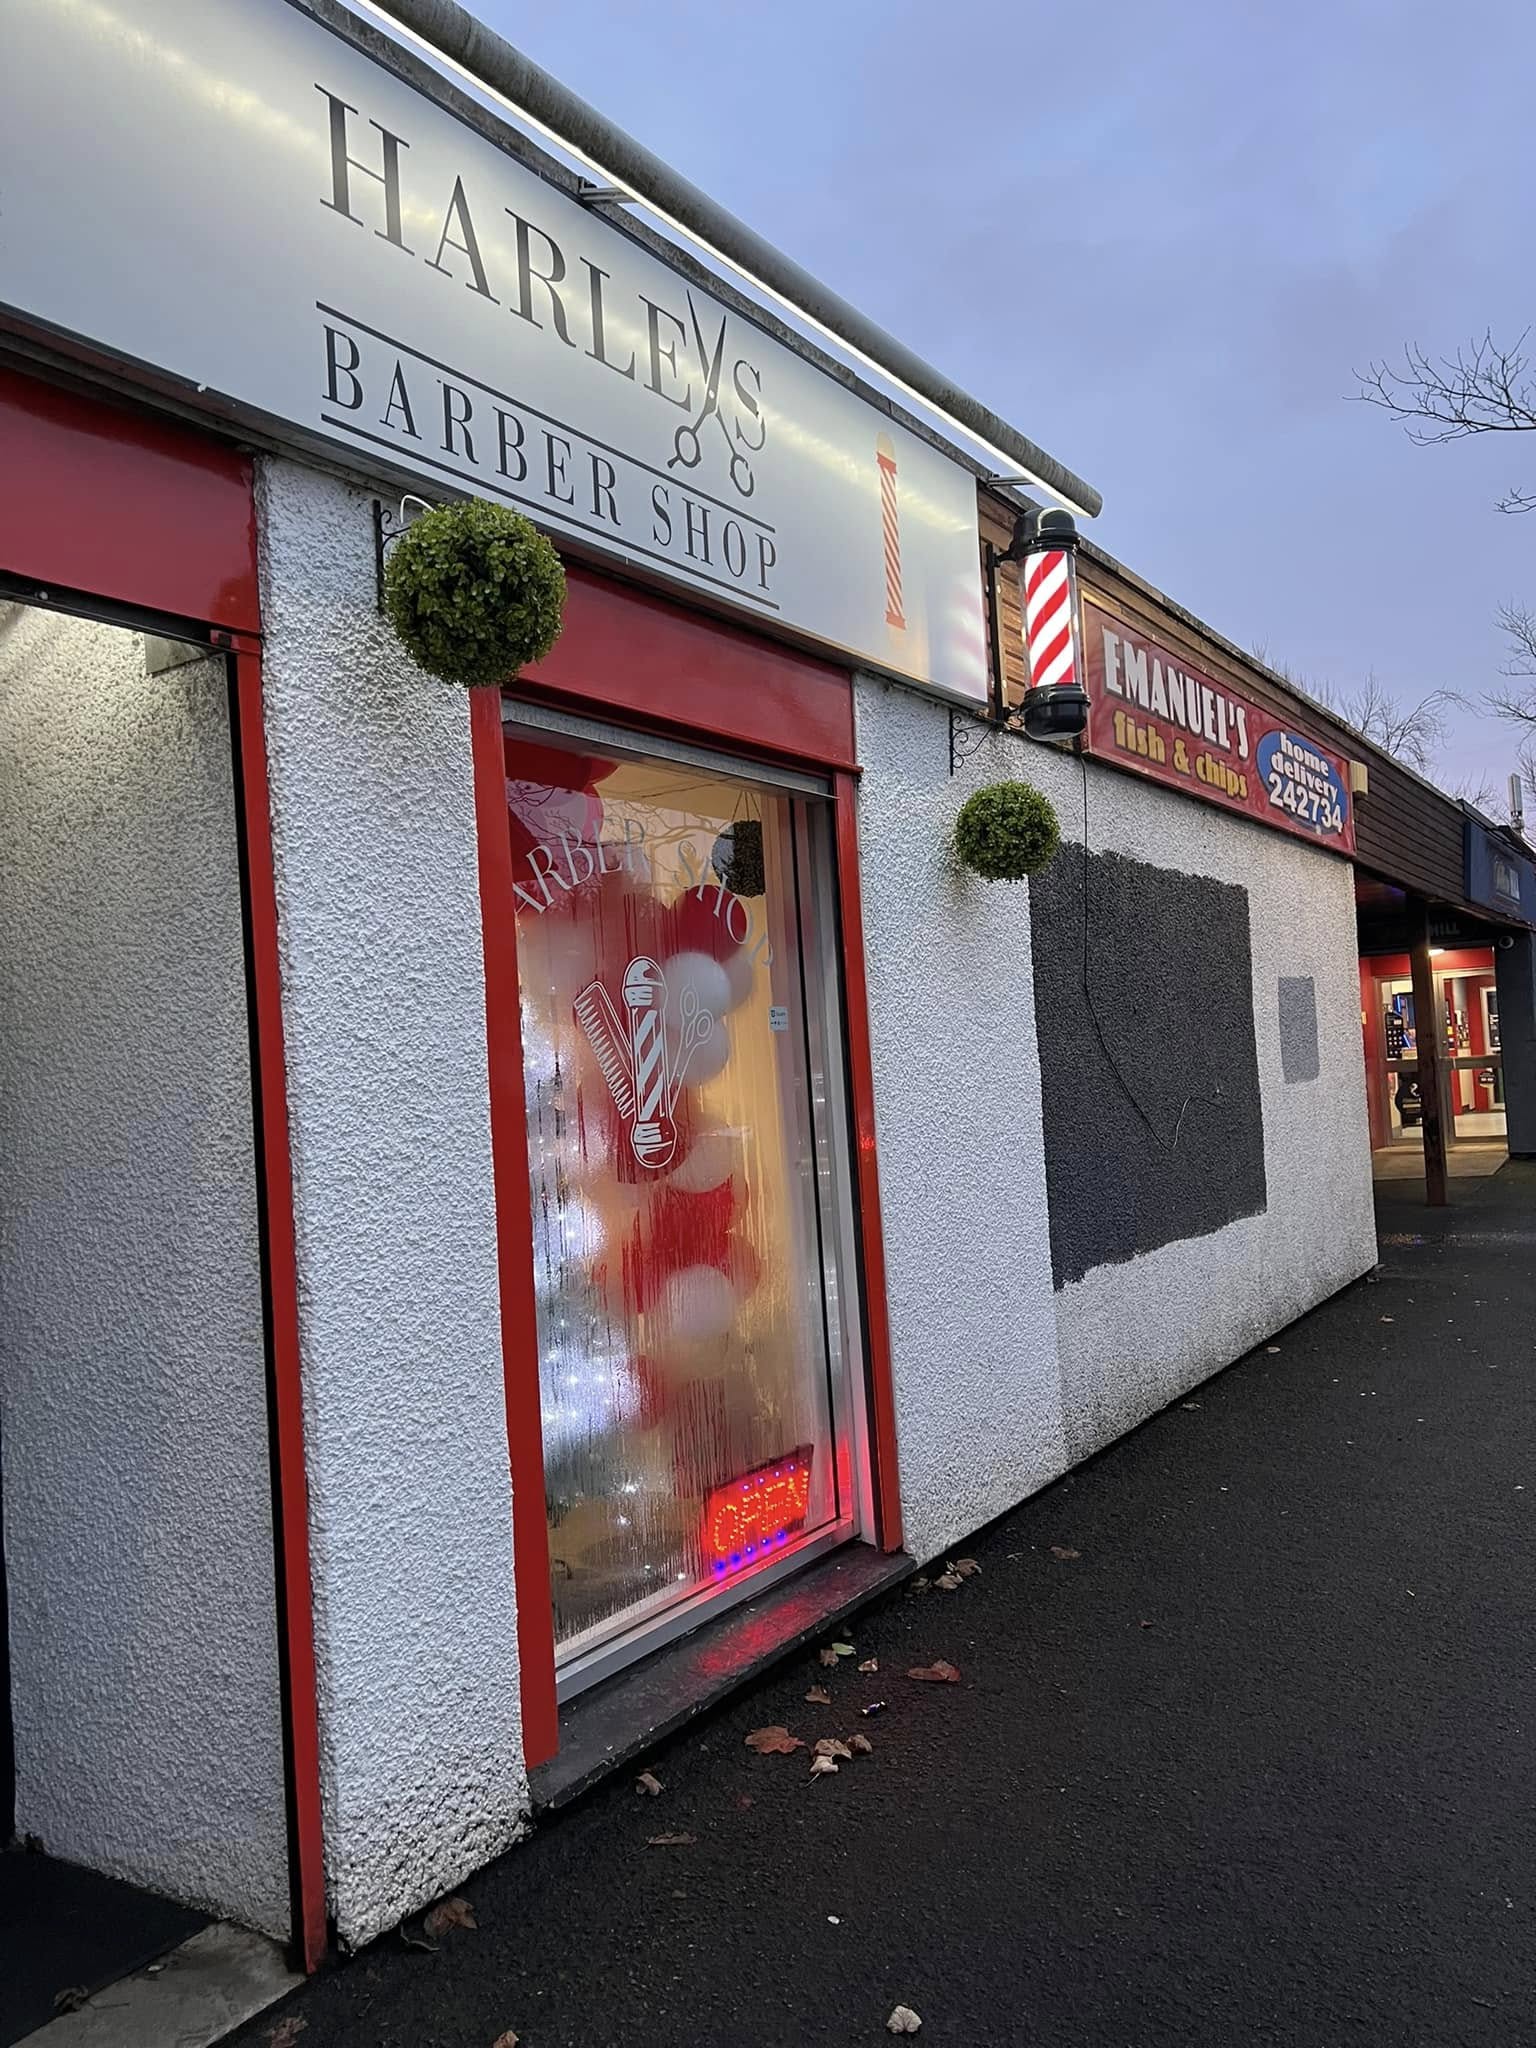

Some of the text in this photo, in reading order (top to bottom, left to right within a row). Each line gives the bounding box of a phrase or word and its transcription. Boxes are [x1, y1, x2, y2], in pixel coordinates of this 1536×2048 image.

[321, 323, 778, 593] BARBER SHOP
[1101, 624, 1249, 761] EMANUEL'S
[1112, 708, 1248, 800] fish & chips
[1270, 752, 1339, 804] delivery
[1279, 731, 1330, 778] home
[1267, 773, 1345, 834] 242734
[511, 817, 653, 914] ARBER
[714, 1472, 809, 1552] OPEN
